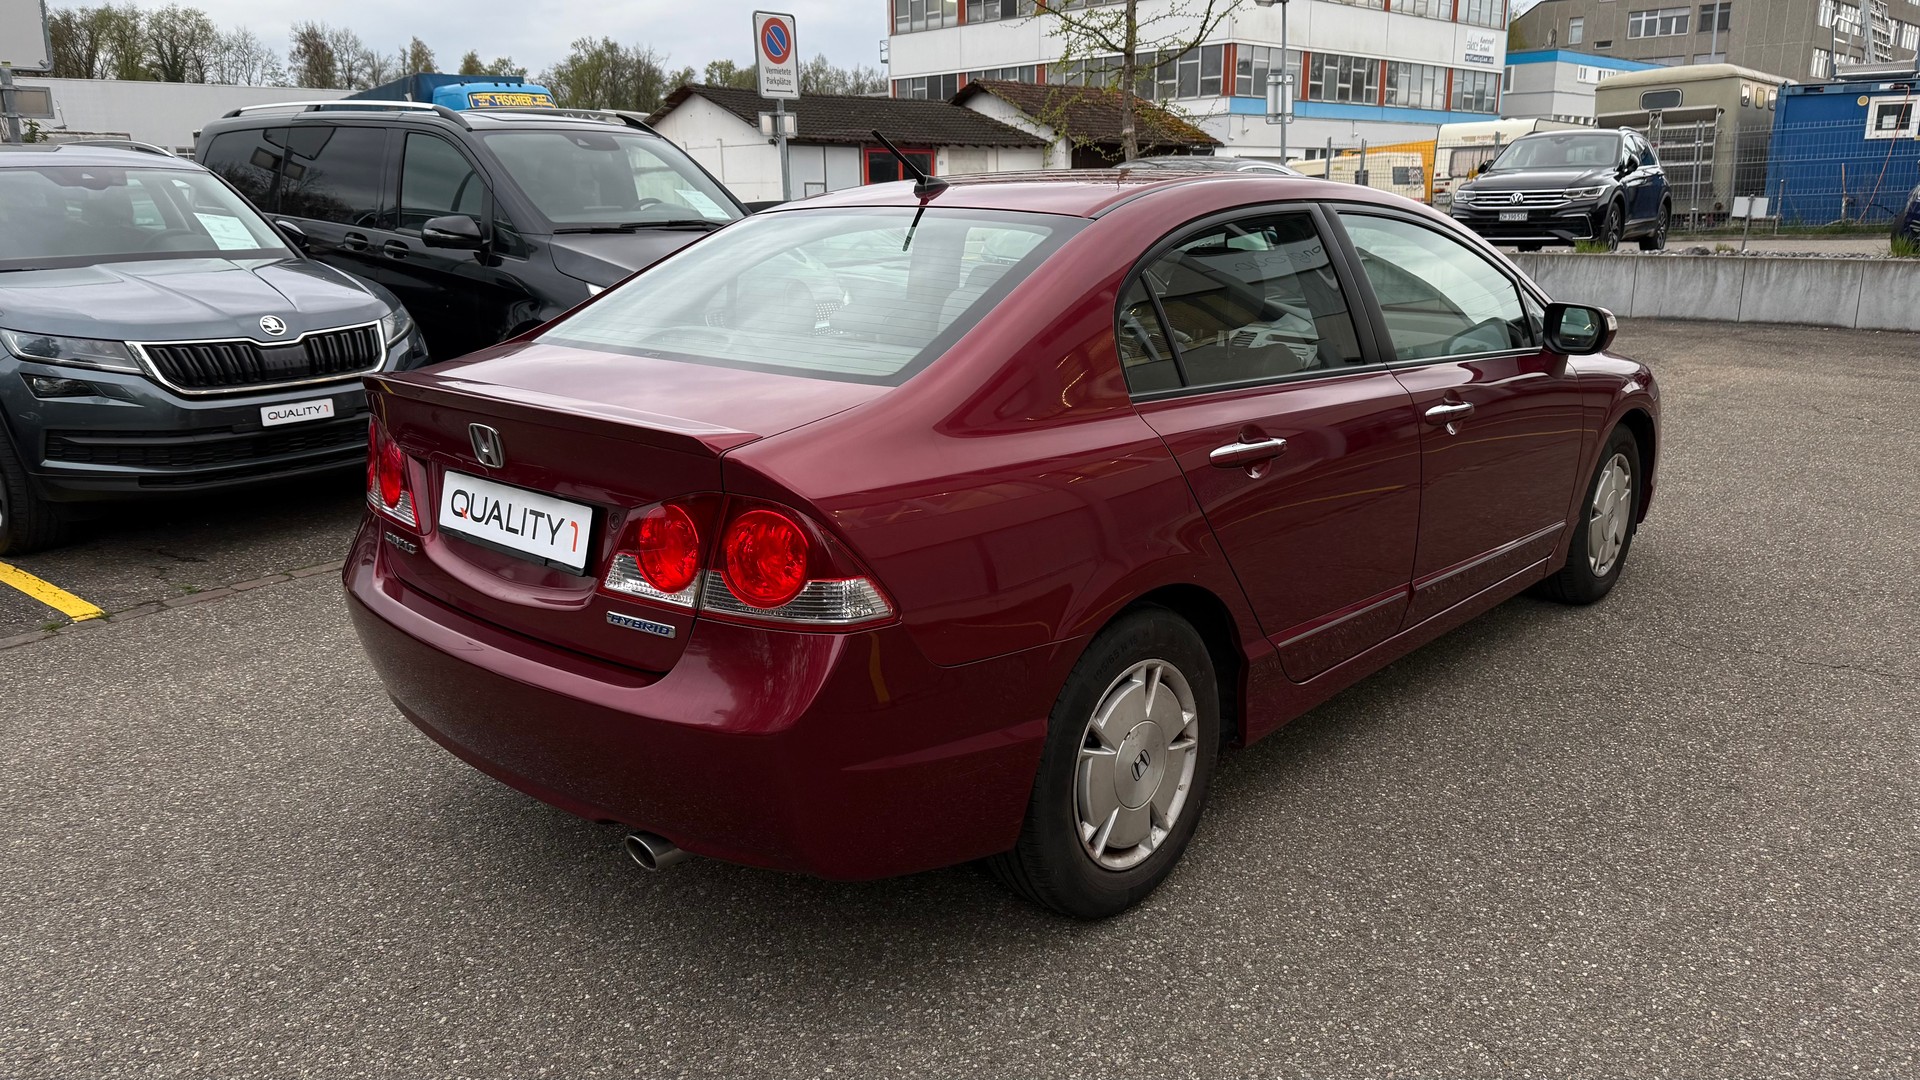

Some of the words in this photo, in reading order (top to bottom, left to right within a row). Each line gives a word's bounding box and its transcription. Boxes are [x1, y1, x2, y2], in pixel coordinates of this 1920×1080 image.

[764, 66, 792, 76] Vermietete
[765, 76, 792, 86] Parkplätze
[494, 95, 534, 106] FISCHER
[267, 404, 322, 420] QUALITY
[450, 489, 566, 546] QUALITY
[610, 614, 671, 635] HYBRID
